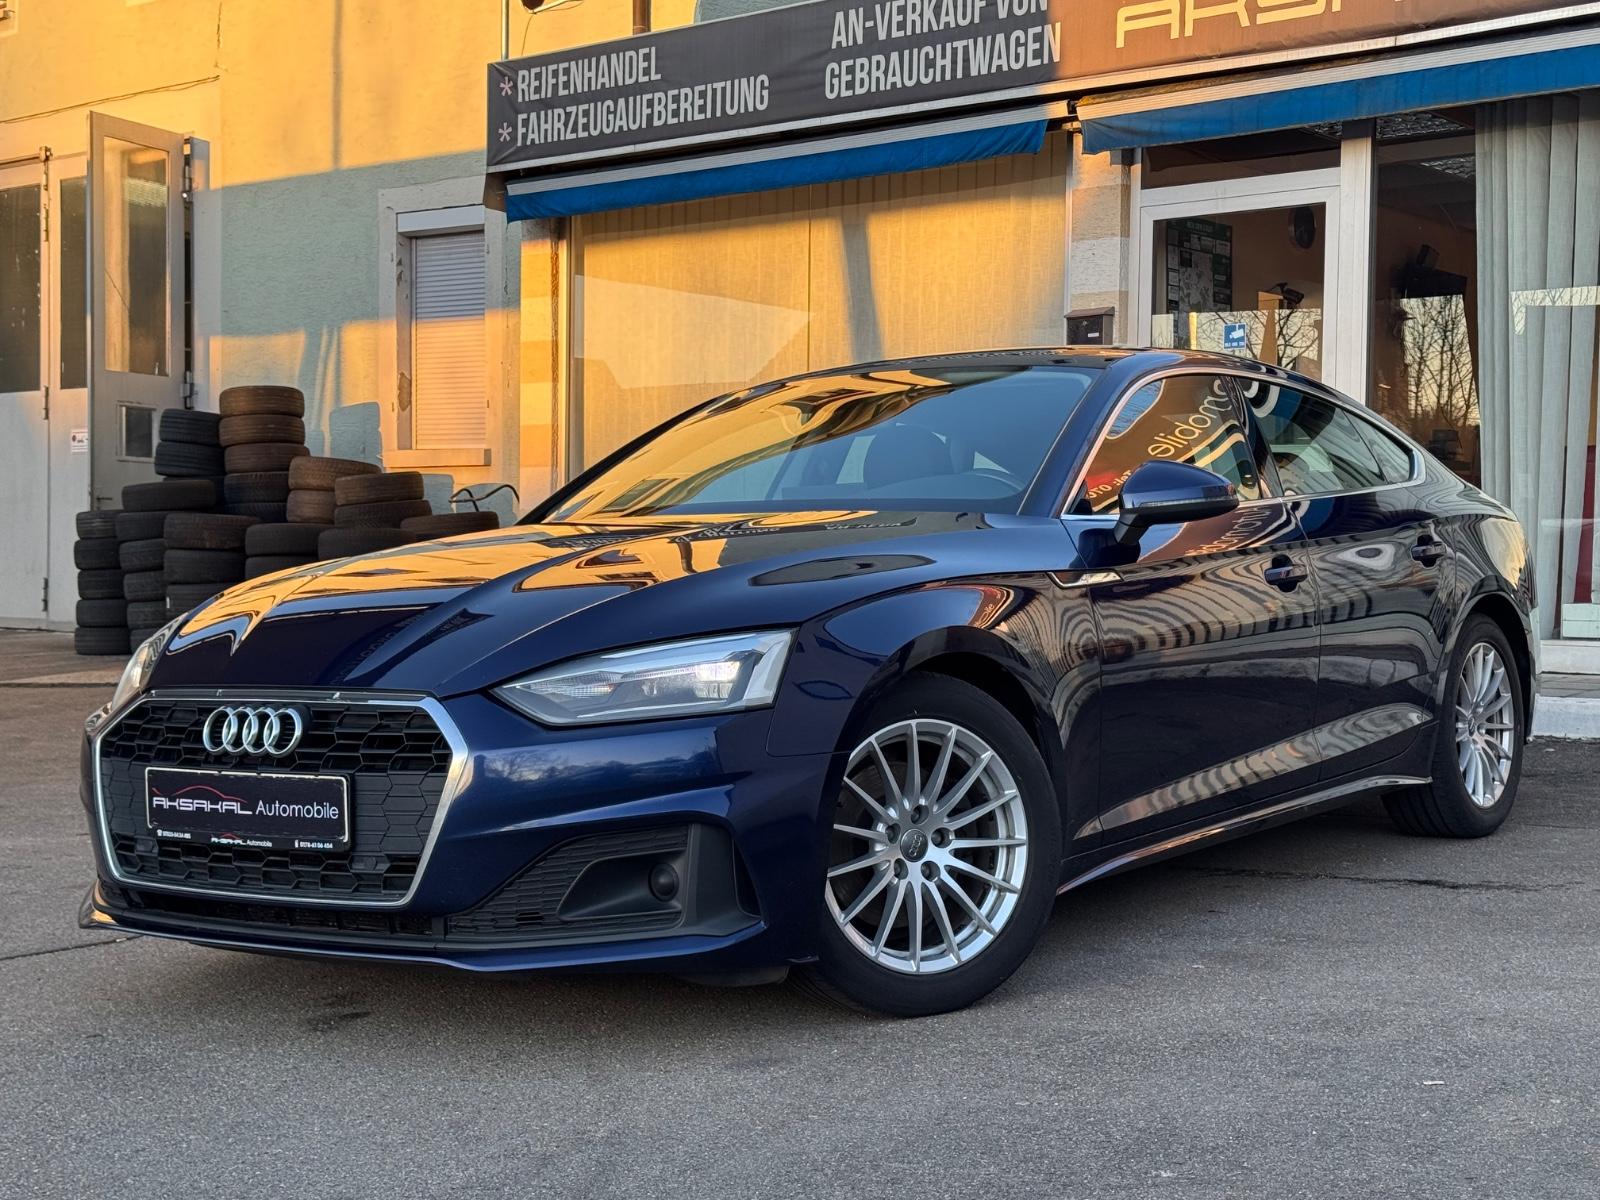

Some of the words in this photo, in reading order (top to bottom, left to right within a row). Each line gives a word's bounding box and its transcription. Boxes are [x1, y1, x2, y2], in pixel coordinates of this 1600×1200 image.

[517, 46, 661, 103] REIFENHANDEL
[824, 22, 1061, 100] GEBRAUCHTWAGEN
[516, 74, 769, 147] FAHRZEUGAUFBEREITUNG
[153, 796, 252, 815] AKSAKAL
[256, 799, 339, 819] Automobile
